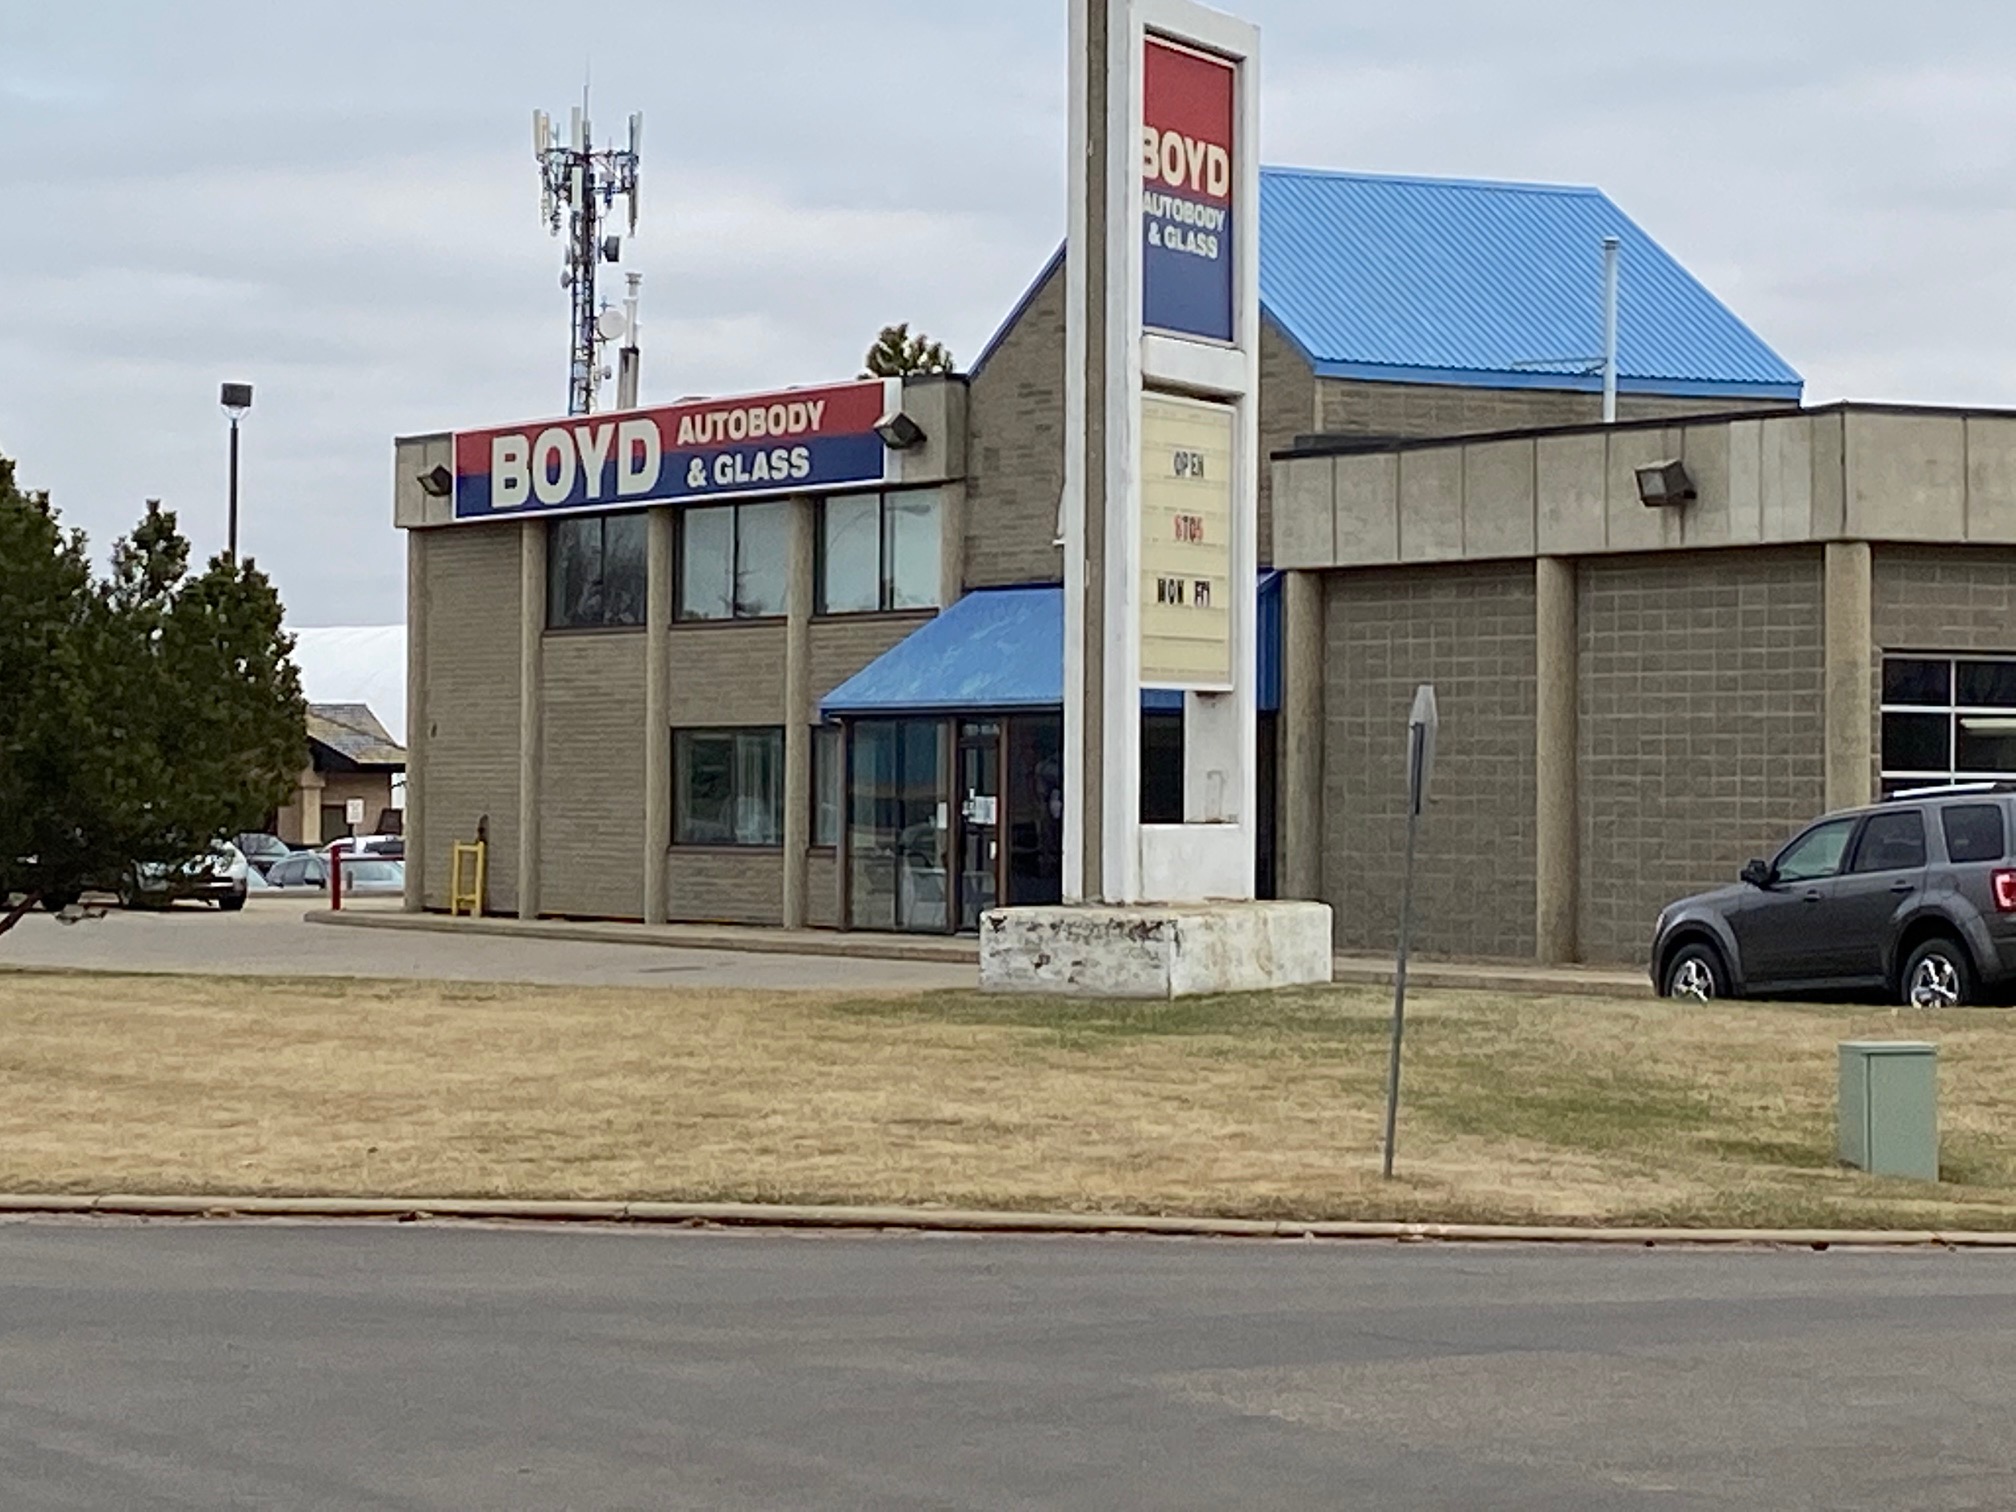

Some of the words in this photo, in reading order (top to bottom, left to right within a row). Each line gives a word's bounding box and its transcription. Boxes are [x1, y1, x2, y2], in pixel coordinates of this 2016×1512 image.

[1143, 125, 1230, 197] BOYD
[1143, 191, 1225, 232] AUTOBODY
[1148, 222, 1162, 246] &
[1164, 225, 1218, 259] GLASS
[677, 400, 827, 446] AUTOBODY
[491, 418, 662, 508] BOYD
[687, 458, 708, 488] &
[713, 446, 811, 485] GLASS
[1174, 451, 1204, 478] OPEN
